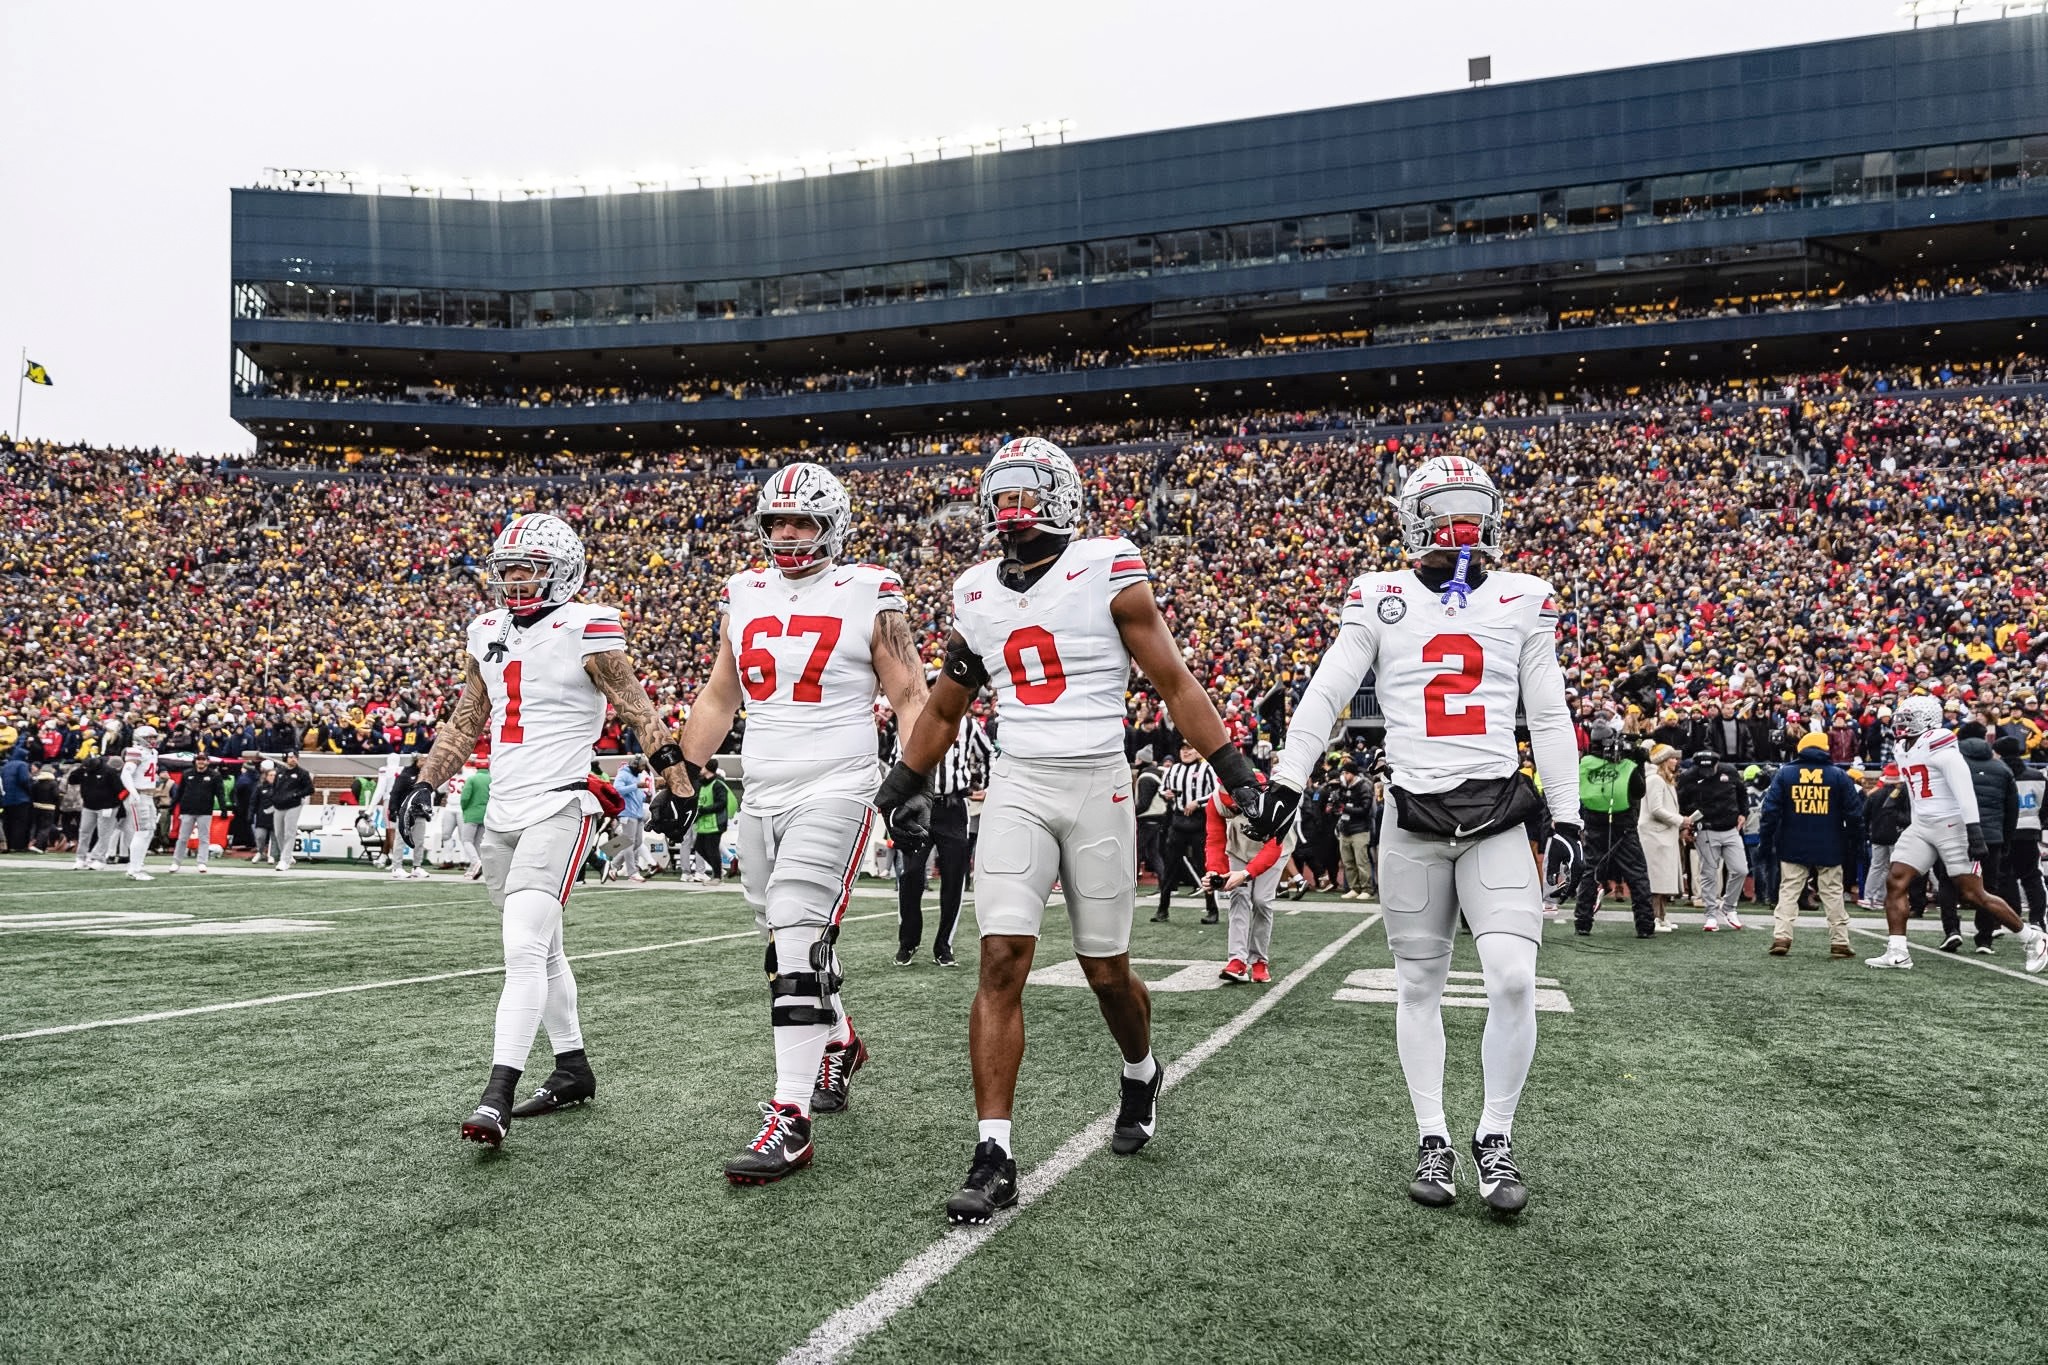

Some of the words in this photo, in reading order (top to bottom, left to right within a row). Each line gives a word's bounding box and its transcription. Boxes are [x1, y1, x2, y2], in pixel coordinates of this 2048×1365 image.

[738, 614, 843, 703] 67
[1004, 625, 1067, 706] 0
[1422, 633, 1487, 738] 2
[500, 660, 524, 744] 1
[1791, 785, 1831, 800] EVENT
[1793, 799, 1829, 815] TEAM
[1799, 768, 1823, 784] M
